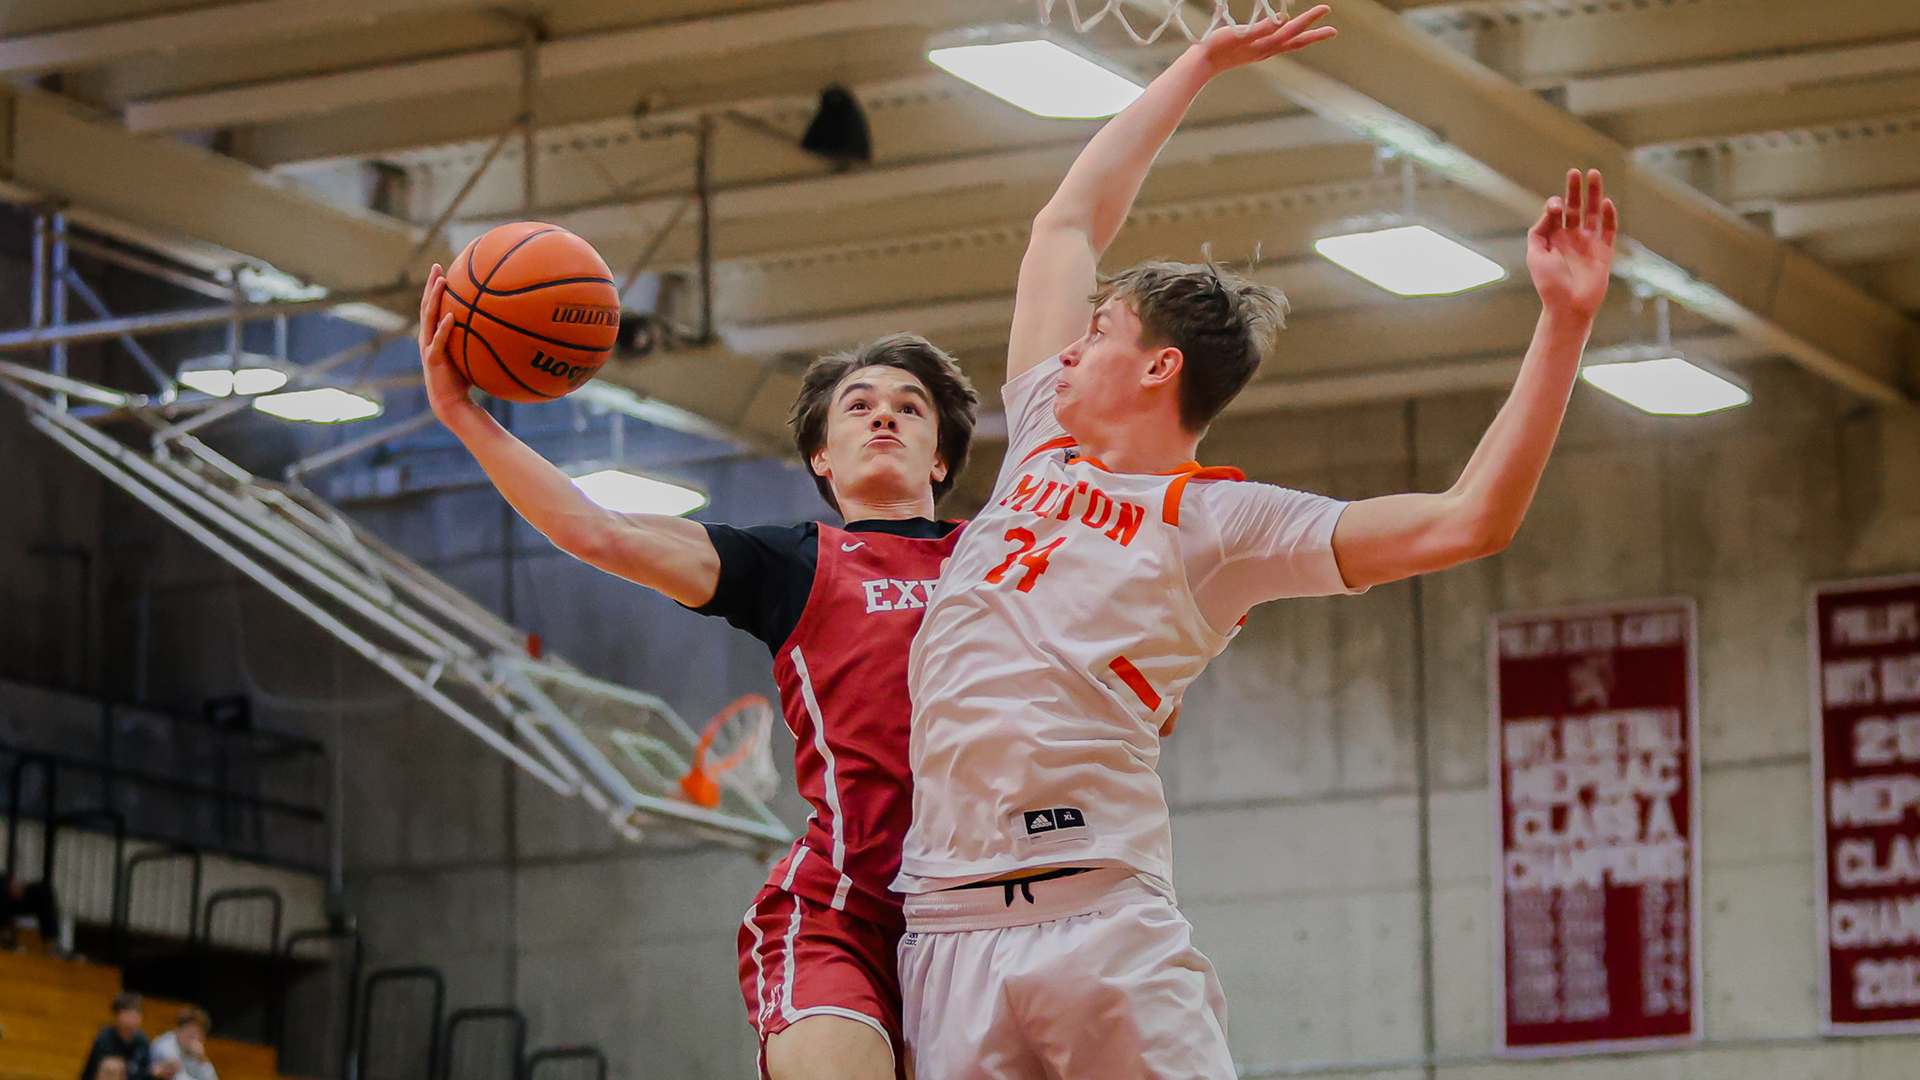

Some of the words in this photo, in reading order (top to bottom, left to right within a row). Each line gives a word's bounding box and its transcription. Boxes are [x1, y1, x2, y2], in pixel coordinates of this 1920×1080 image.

[983, 526, 1067, 593] 24
[1649, 797, 1678, 838] A
[1837, 835, 1920, 885] CLA
